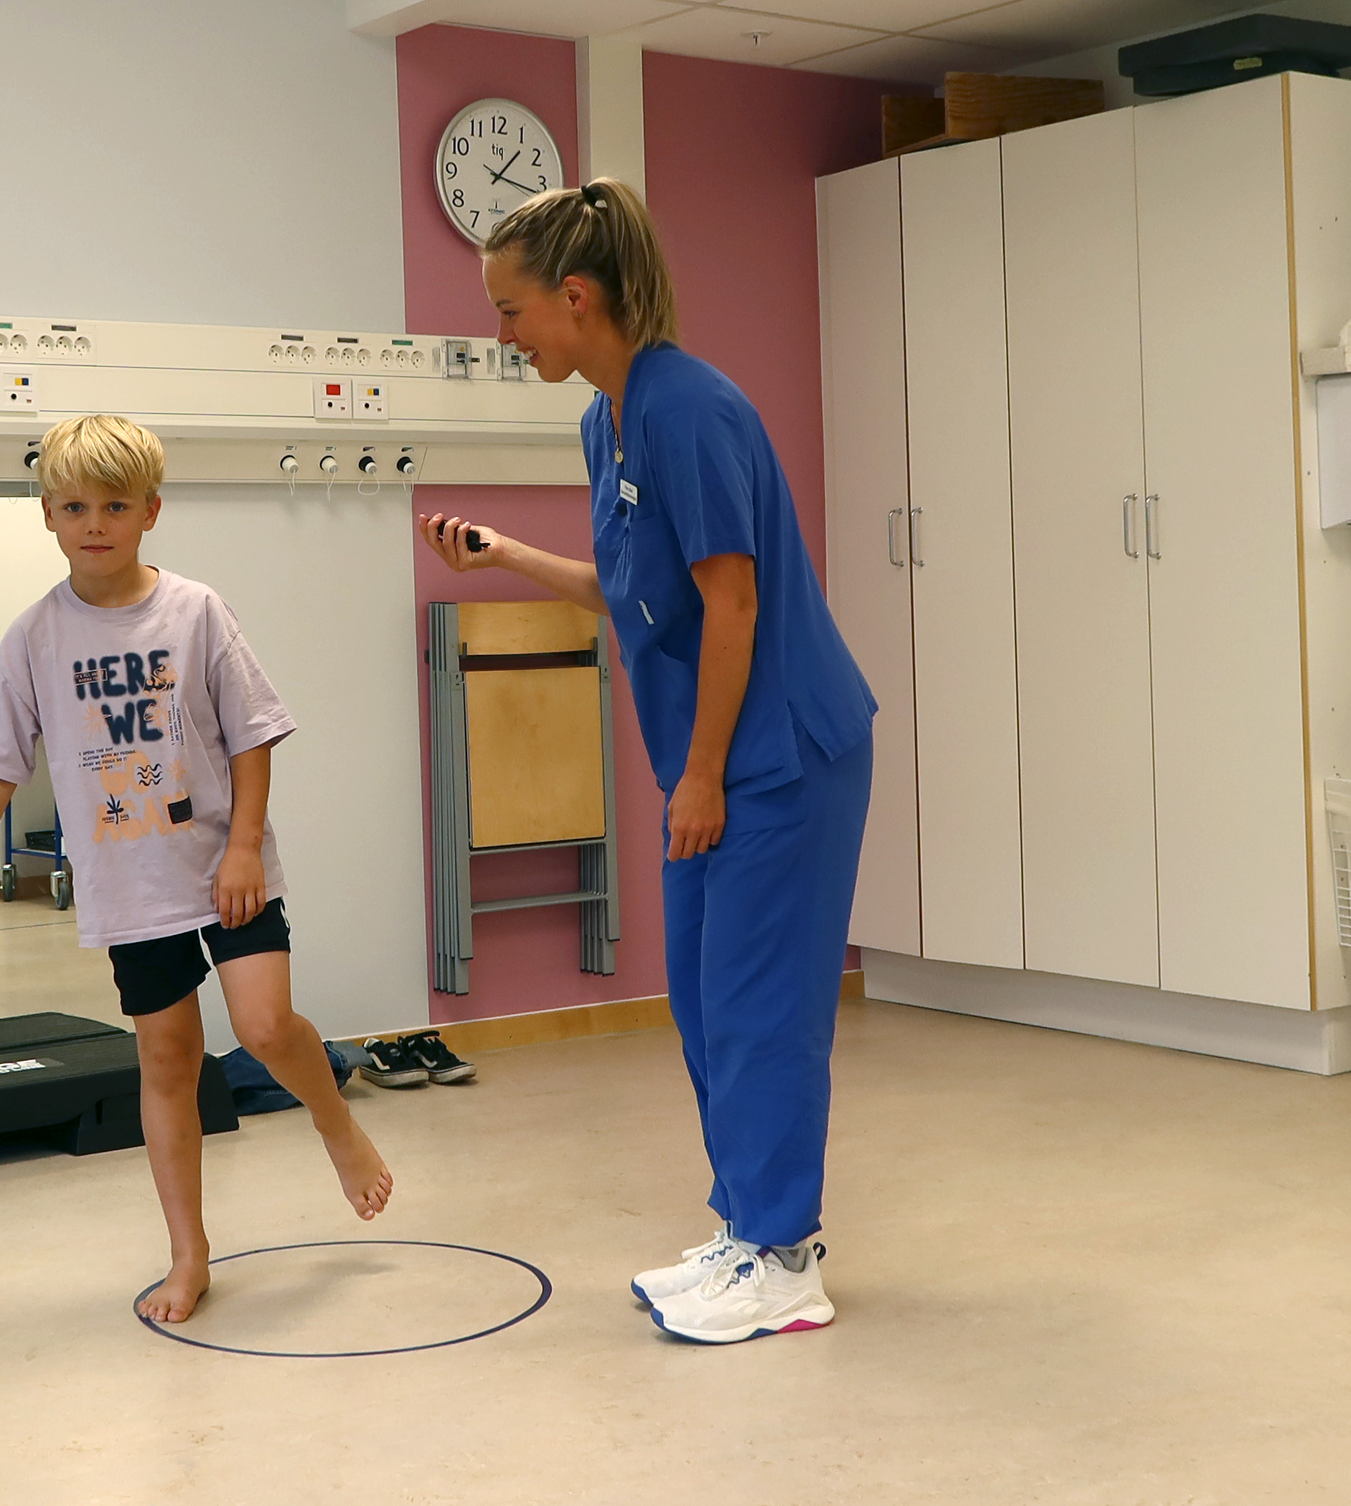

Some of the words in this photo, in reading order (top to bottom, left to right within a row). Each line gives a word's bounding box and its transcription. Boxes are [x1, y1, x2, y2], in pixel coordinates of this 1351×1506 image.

[470, 118, 483, 138] 11
[491, 115, 508, 136] 12
[519, 125, 524, 145] 1
[452, 136, 470, 156] 10
[491, 143, 504, 161] tiq
[531, 148, 542, 167] 2
[445, 161, 458, 180] 9
[537, 175, 547, 191] 3
[452, 188, 465, 208] 8
[469, 210, 480, 228] 7
[73, 649, 175, 700] HERE
[101, 699, 164, 745] WE
